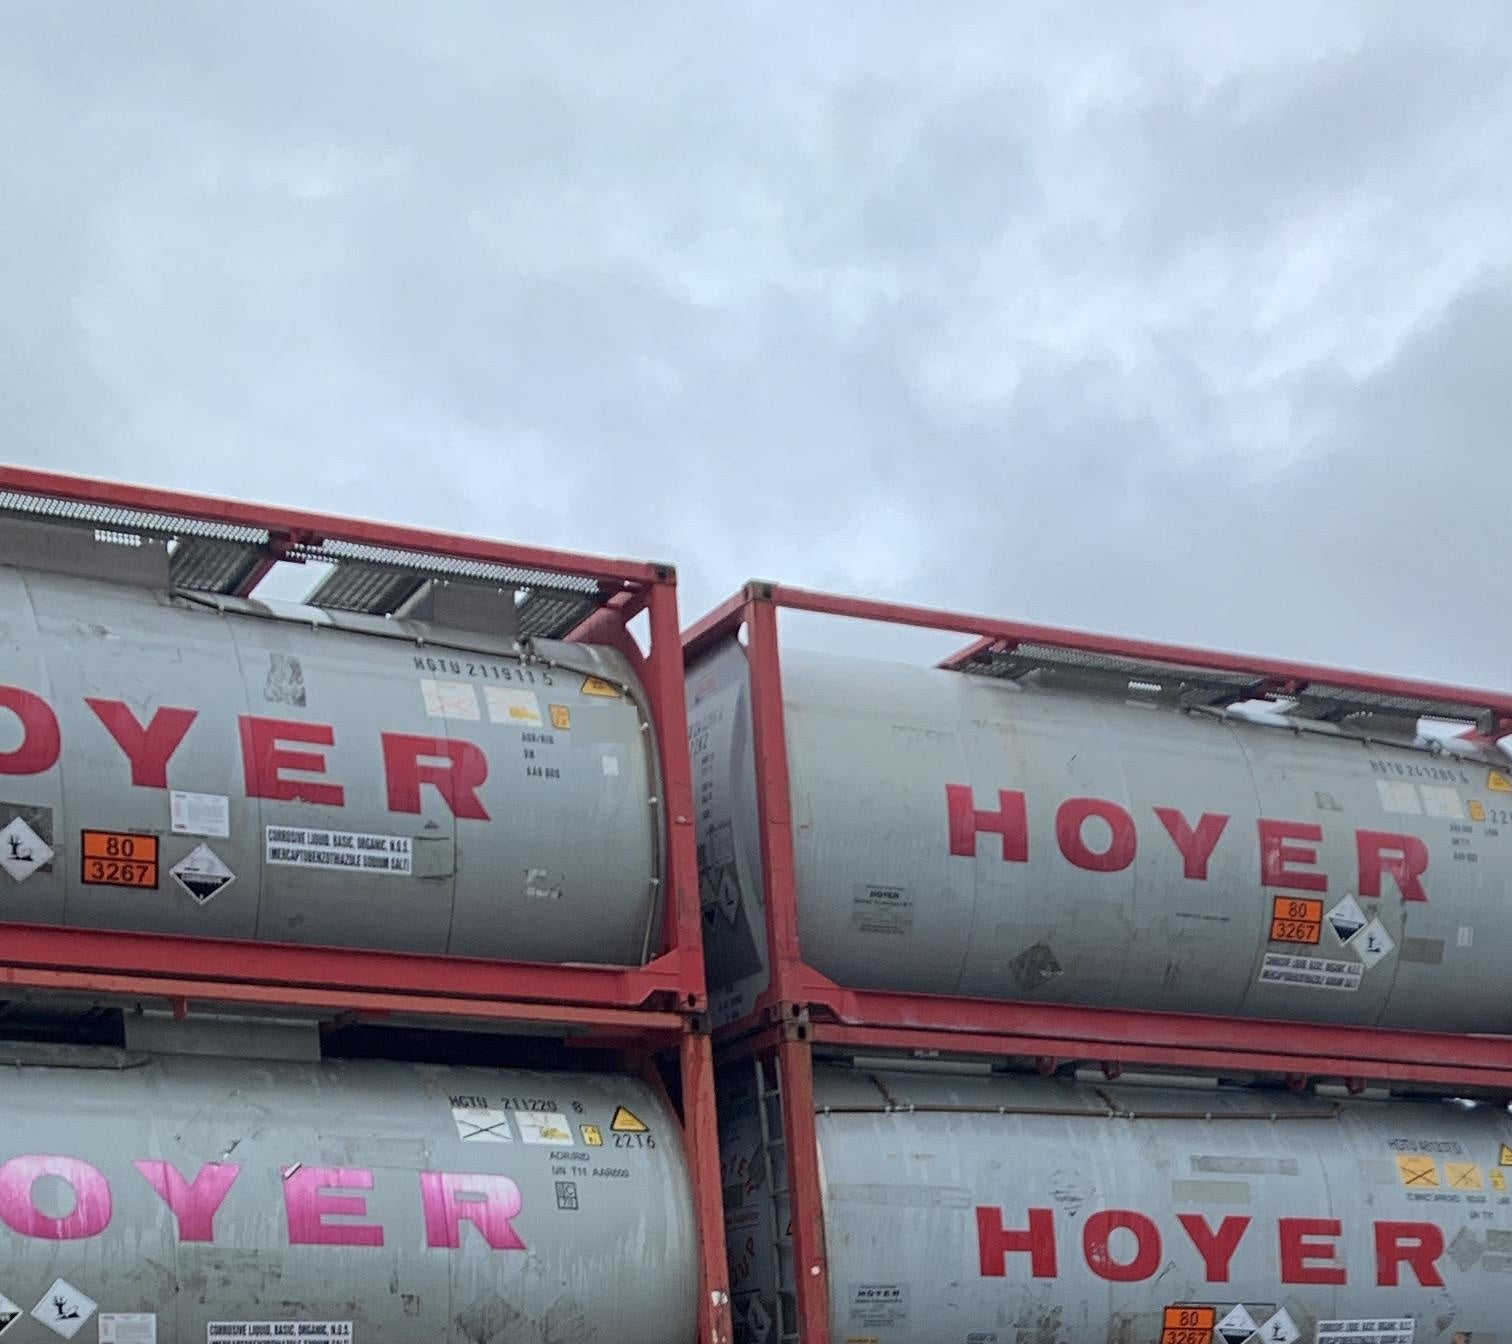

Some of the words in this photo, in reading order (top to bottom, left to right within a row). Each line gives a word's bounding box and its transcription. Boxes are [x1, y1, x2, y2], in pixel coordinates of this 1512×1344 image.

[106, 837, 135, 858] 80
[945, 783, 1428, 902] HOYER
[91, 861, 149, 884] 3267
[1288, 902, 1308, 918] 80
[1276, 922, 1316, 940] 3267
[976, 1205, 1445, 1287] HOYER
[1180, 1310, 1200, 1327] 80
